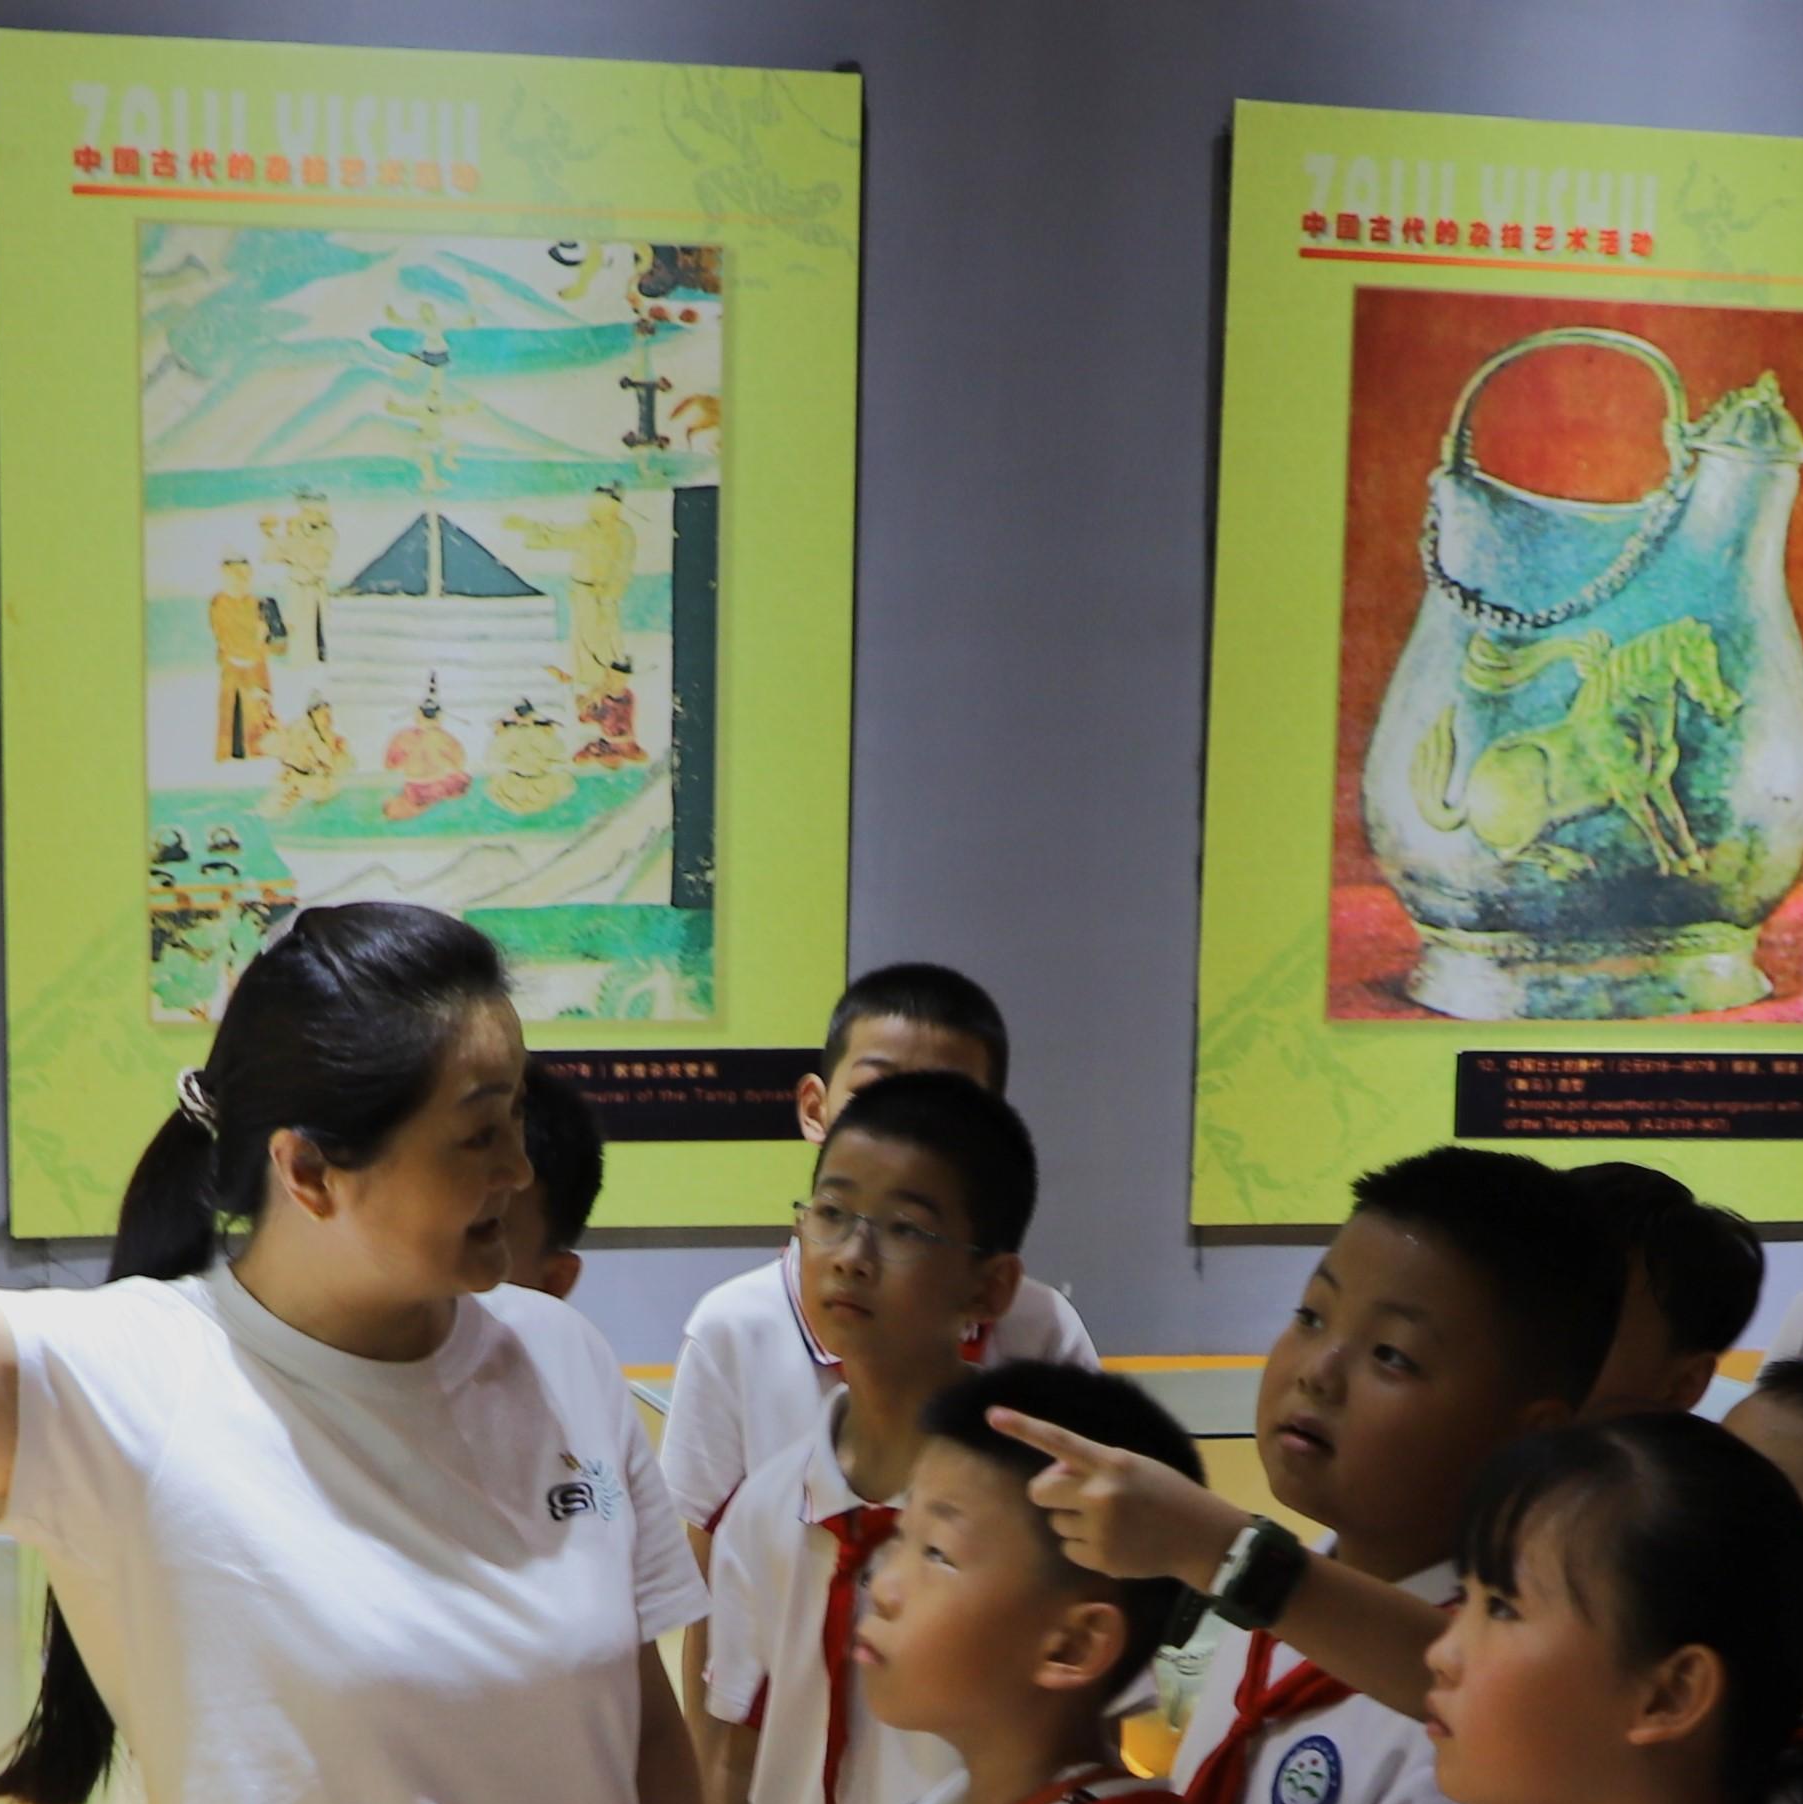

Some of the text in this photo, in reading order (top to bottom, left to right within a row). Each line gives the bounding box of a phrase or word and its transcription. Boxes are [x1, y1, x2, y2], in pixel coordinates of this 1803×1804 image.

[1302, 212, 1654, 259] 中国古代的杂技艺术活动
